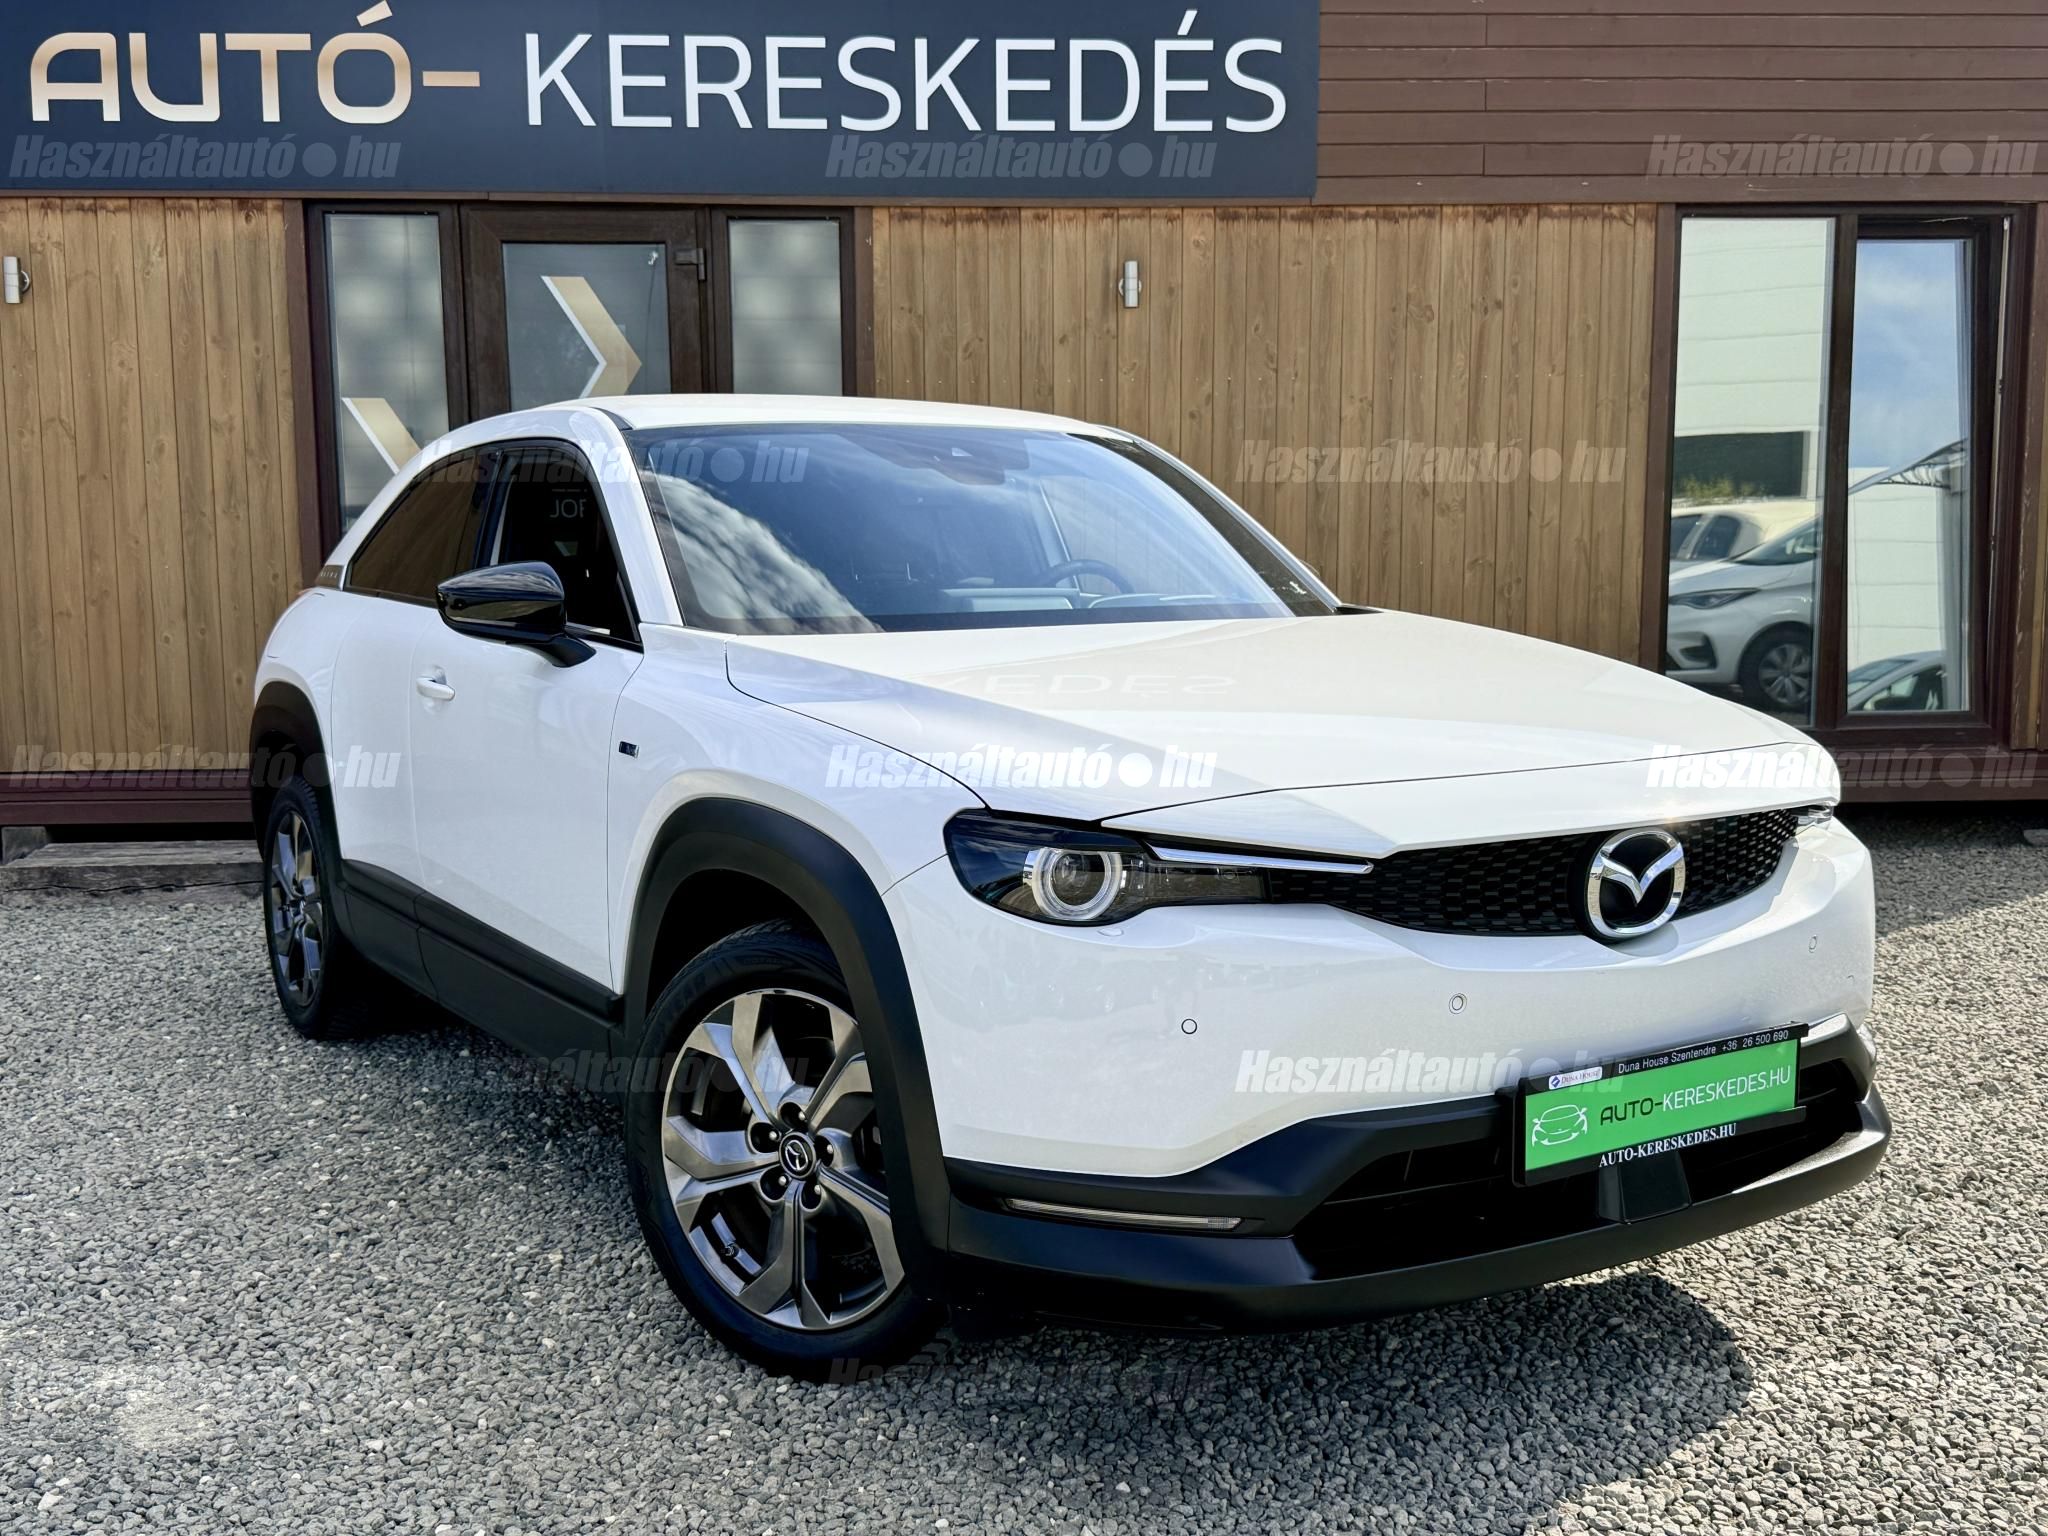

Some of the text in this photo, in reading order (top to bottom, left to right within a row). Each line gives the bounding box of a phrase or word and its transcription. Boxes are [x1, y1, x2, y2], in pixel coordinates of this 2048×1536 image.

[525, 9, 1287, 133] KERESKEDÉS
[1618, 1029, 1789, 1075] Duna House Szentendre +36 26 500 690
[1600, 1065, 1791, 1126] AUTO-KERESKEDES.HU
[1598, 1122, 1737, 1167] AUTO-KERESKEDES.HU
